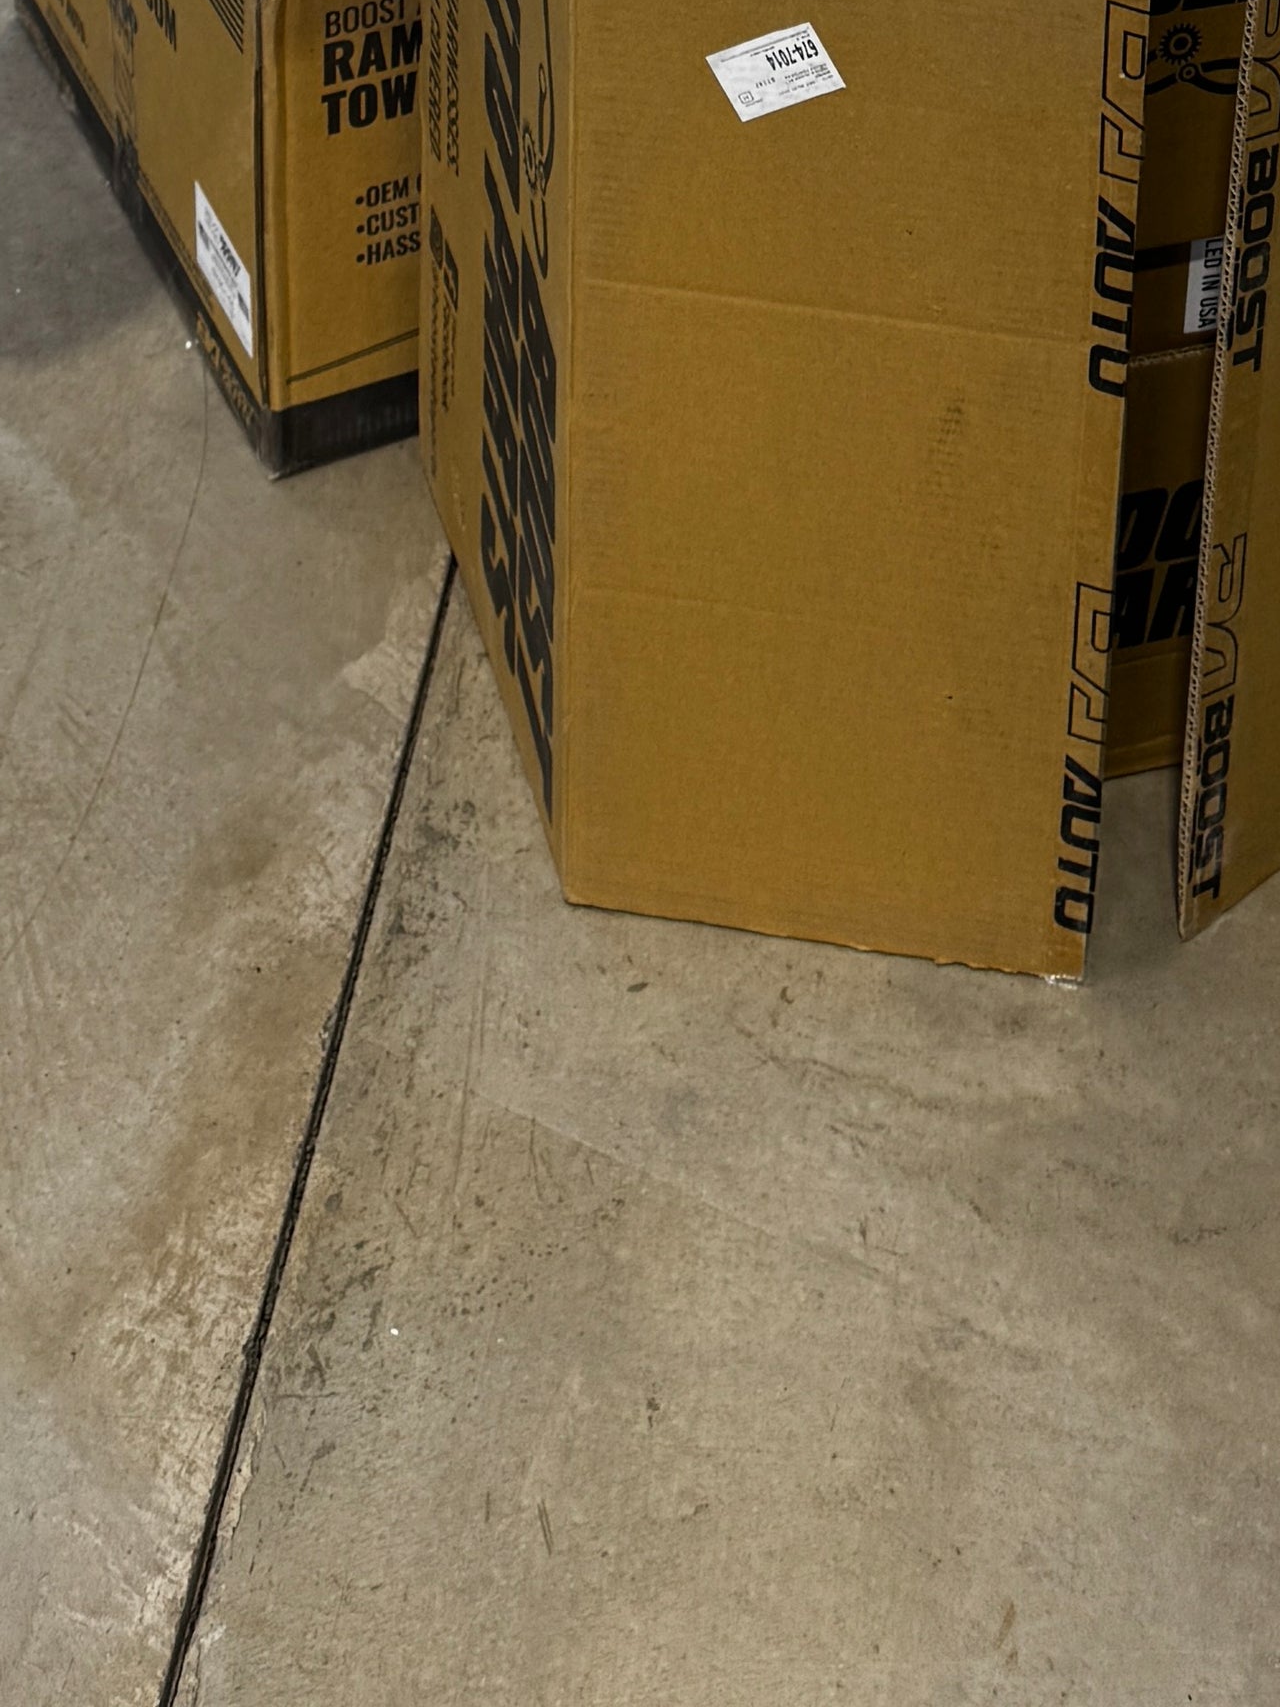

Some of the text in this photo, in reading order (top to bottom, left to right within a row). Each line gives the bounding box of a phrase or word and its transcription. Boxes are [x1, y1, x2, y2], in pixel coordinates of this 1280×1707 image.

[323, 19, 423, 86] RAM
[765, 39, 819, 71] 674-7014
[321, 71, 418, 136] TOW
[365, 176, 410, 208] OEM
[365, 202, 421, 237] CUST
[366, 230, 421, 267] HASS
[1229, 145, 1280, 372] BOOST
[1087, 195, 1137, 398] AUTO
[1197, 297, 1219, 329] USA
[481, 150, 520, 687] PARTS
[517, 232, 557, 829] BOOST
[1191, 692, 1236, 900] BOOST
[1053, 753, 1103, 935] AUTO
